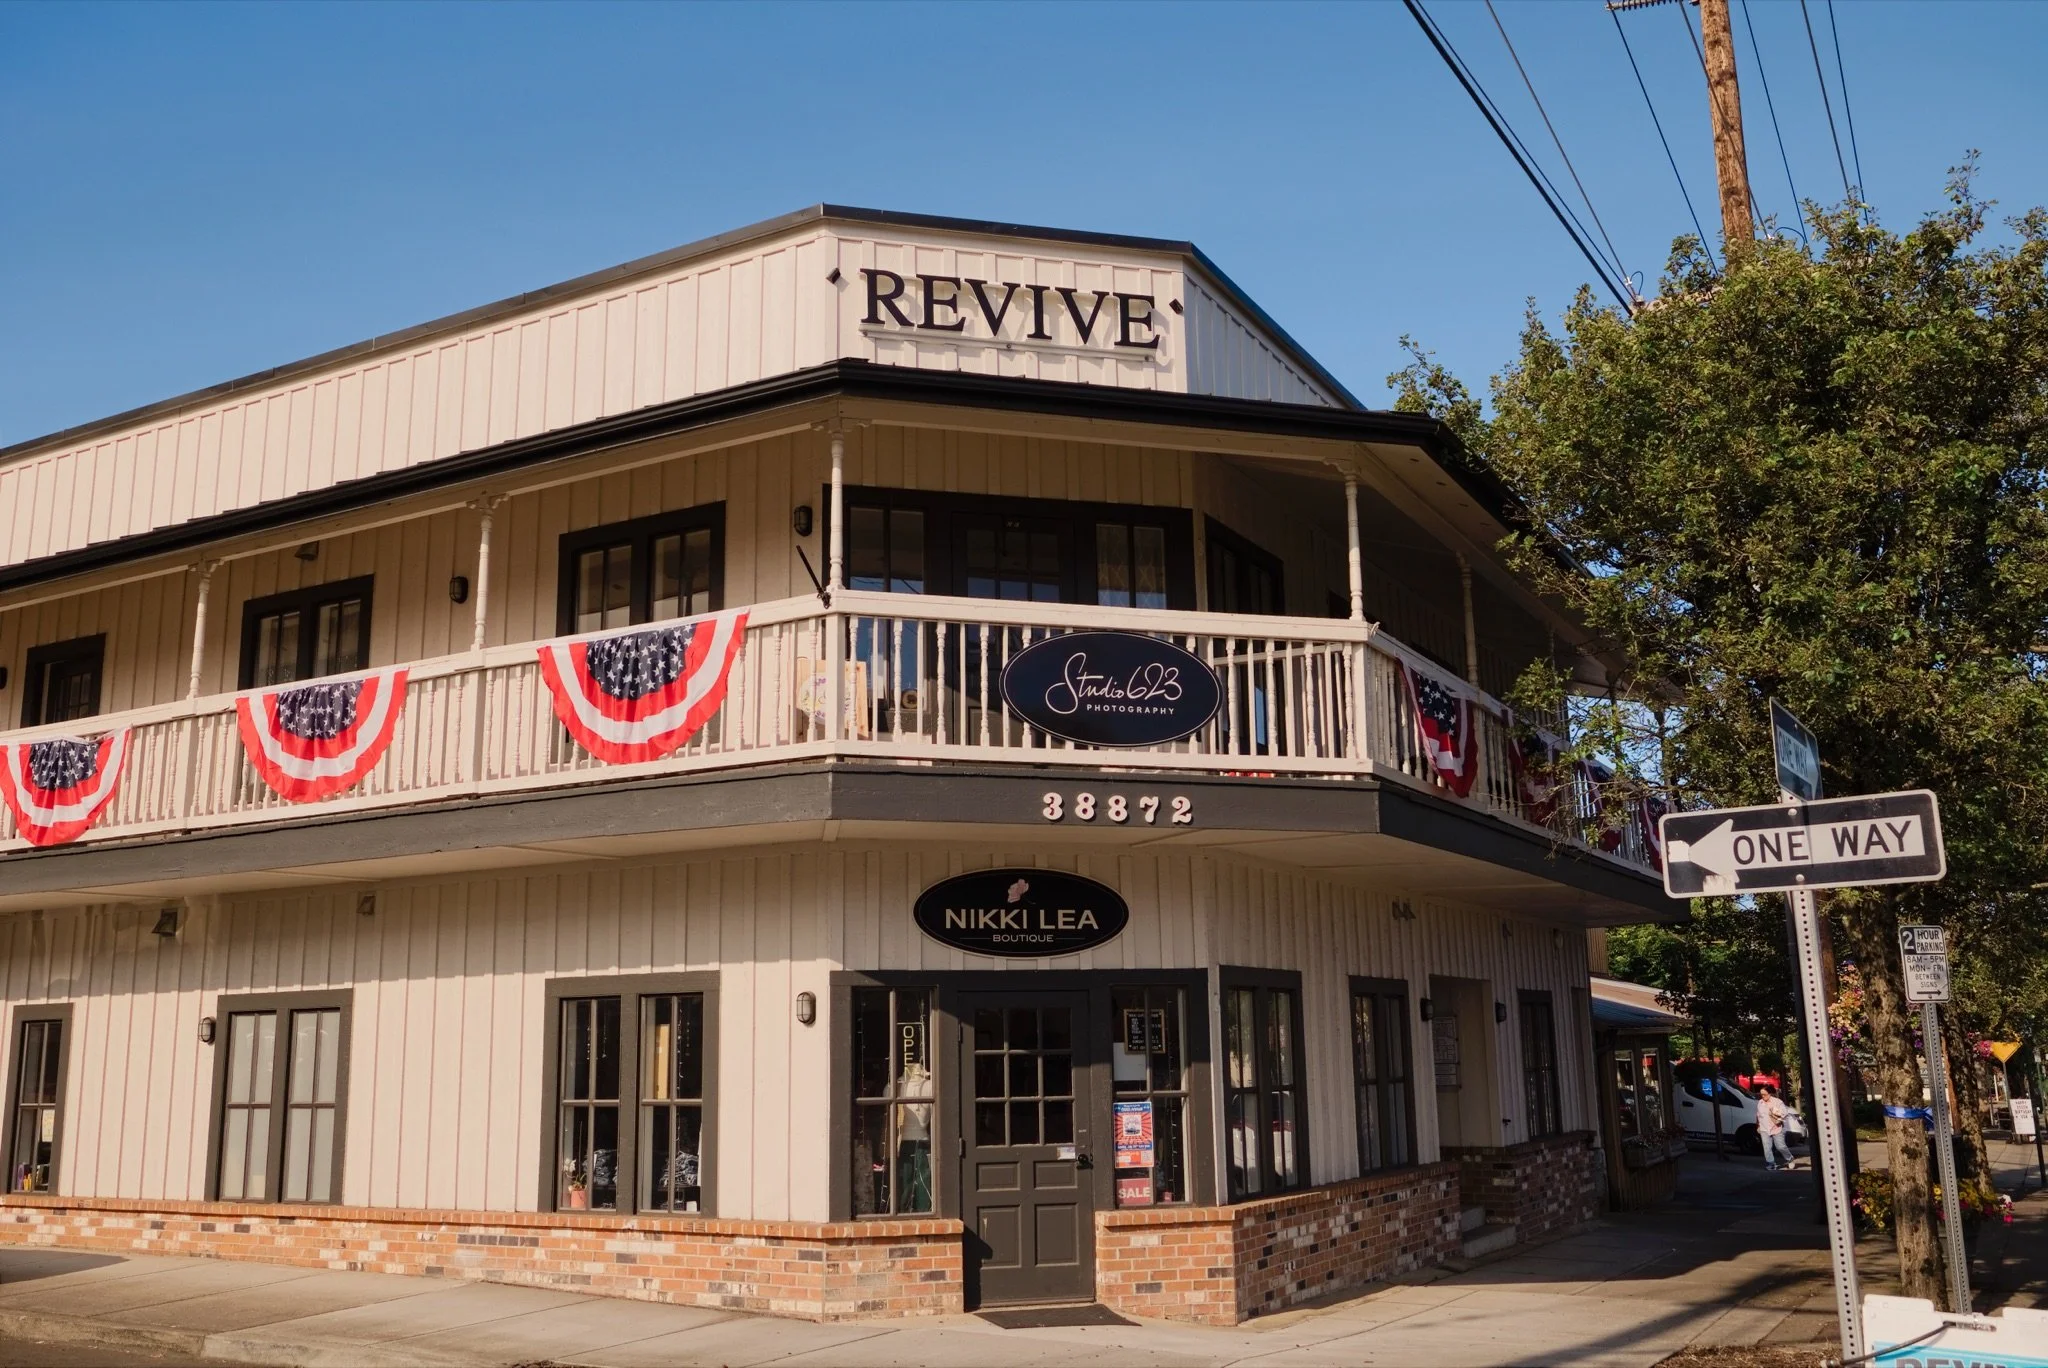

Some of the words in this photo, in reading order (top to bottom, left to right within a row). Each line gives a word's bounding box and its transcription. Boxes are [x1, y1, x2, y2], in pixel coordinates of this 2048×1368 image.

[860, 267, 1161, 349] REVIVE
[1086, 703, 1175, 715] PHOTOGRAPHY
[1042, 792, 1193, 824] 38872
[1732, 829, 1809, 866] ONE
[1831, 820, 1912, 858] WAY
[945, 908, 1028, 929] NIKKI
[1039, 909, 1099, 930] LEA
[992, 934, 1054, 943] BOUTIQUE
[1902, 930, 1915, 950] 2
[1917, 930, 1940, 940] HOUR
[1916, 942, 1944, 952] PARKING
[1909, 964, 1926, 972] MON
[1118, 1187, 1151, 1199] SALE
